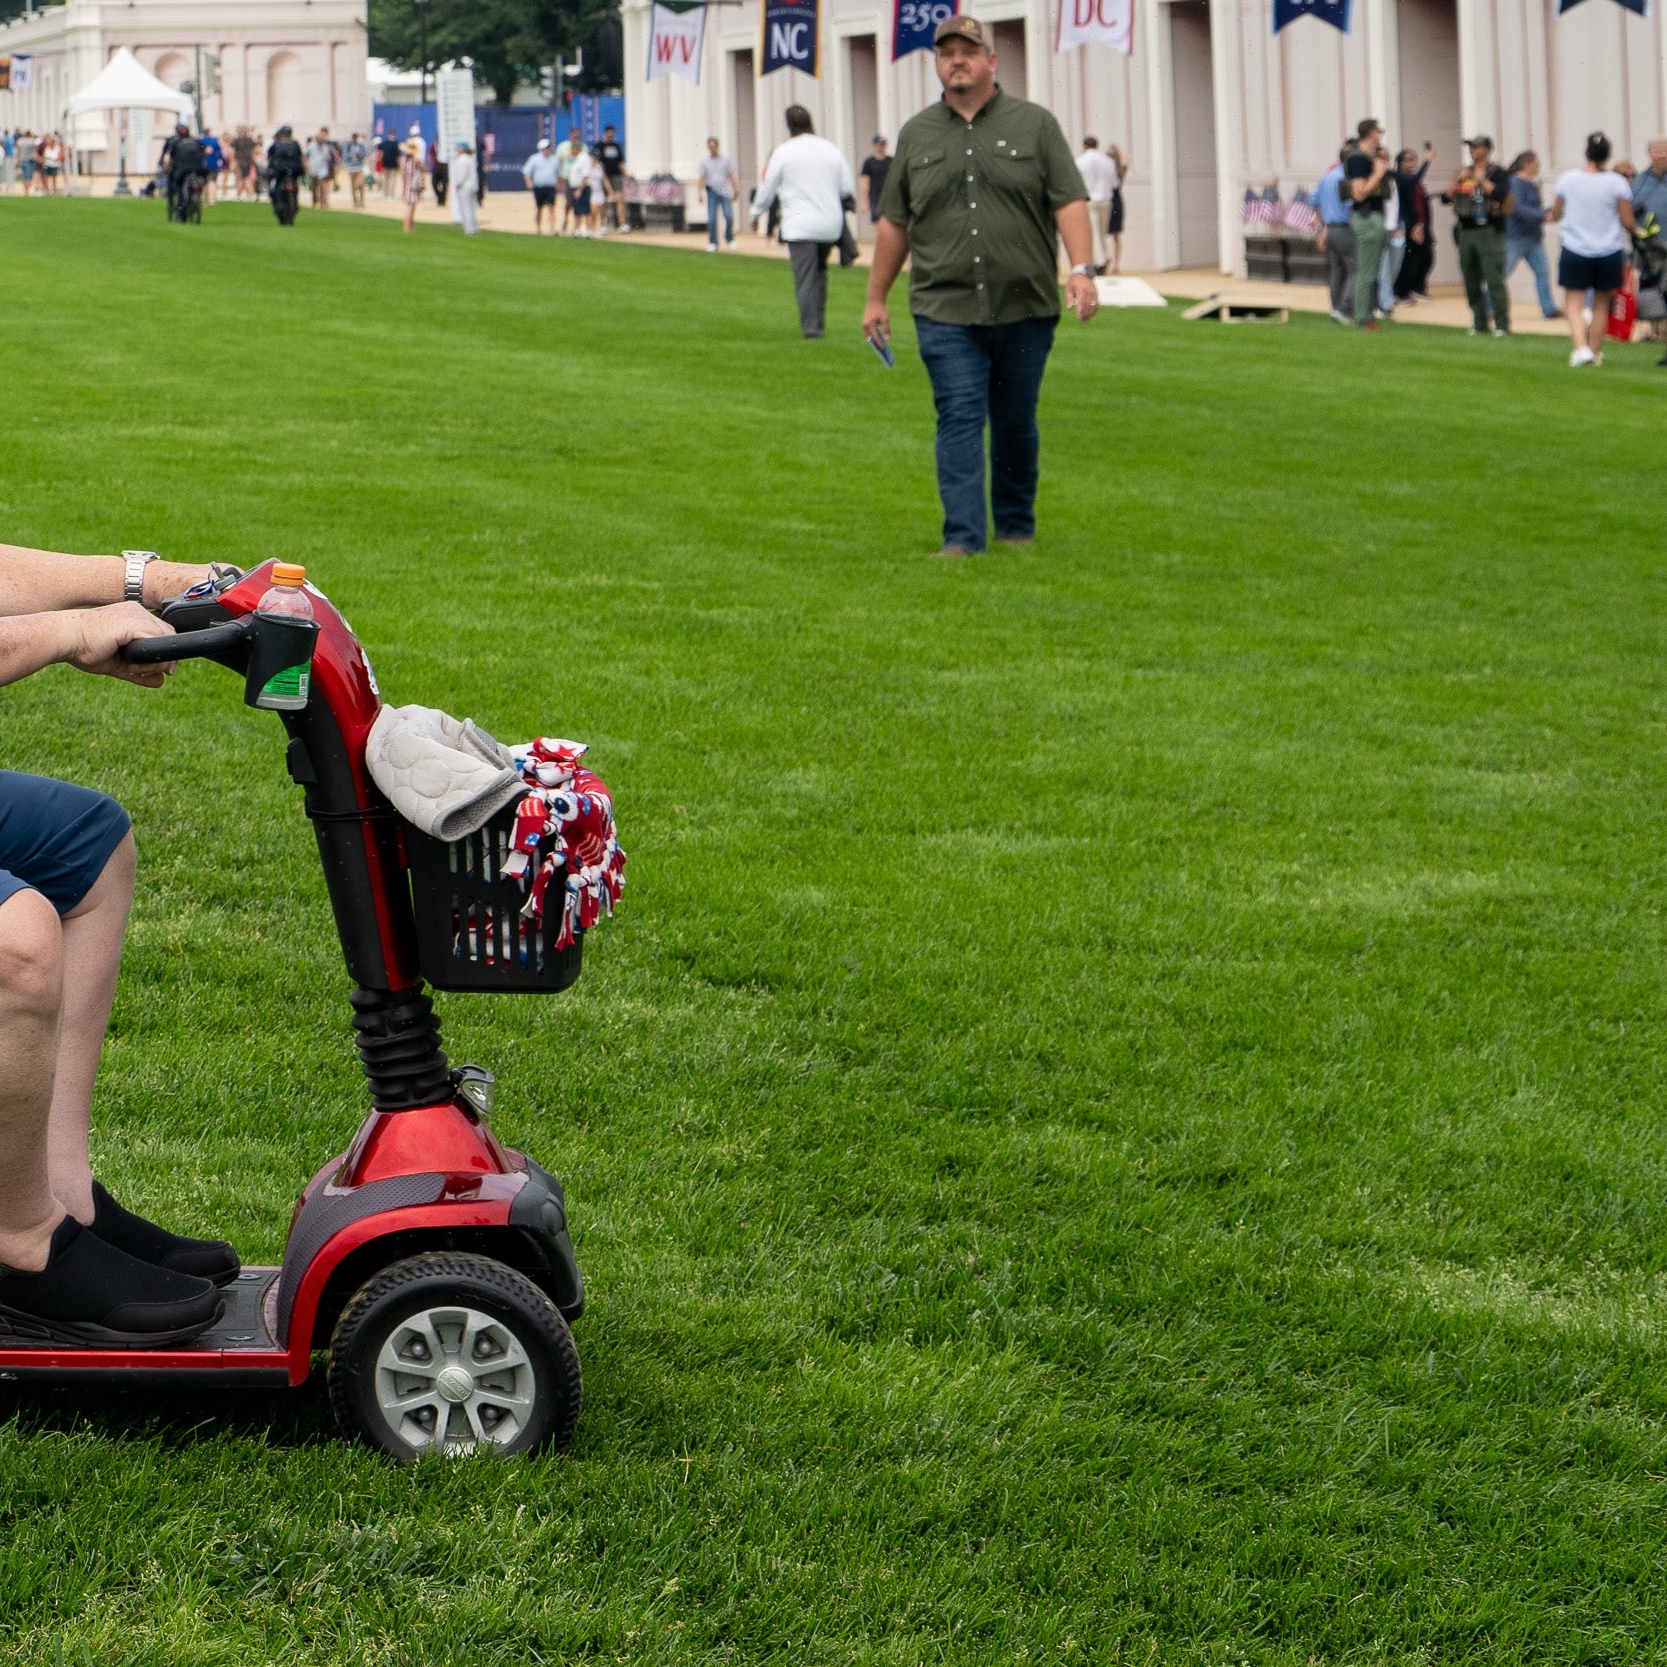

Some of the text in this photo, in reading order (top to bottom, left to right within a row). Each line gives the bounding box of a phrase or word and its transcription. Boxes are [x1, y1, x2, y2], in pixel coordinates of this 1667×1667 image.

[900, 2, 952, 32] 250
[655, 33, 697, 64] WV
[771, 22, 809, 60] NC
